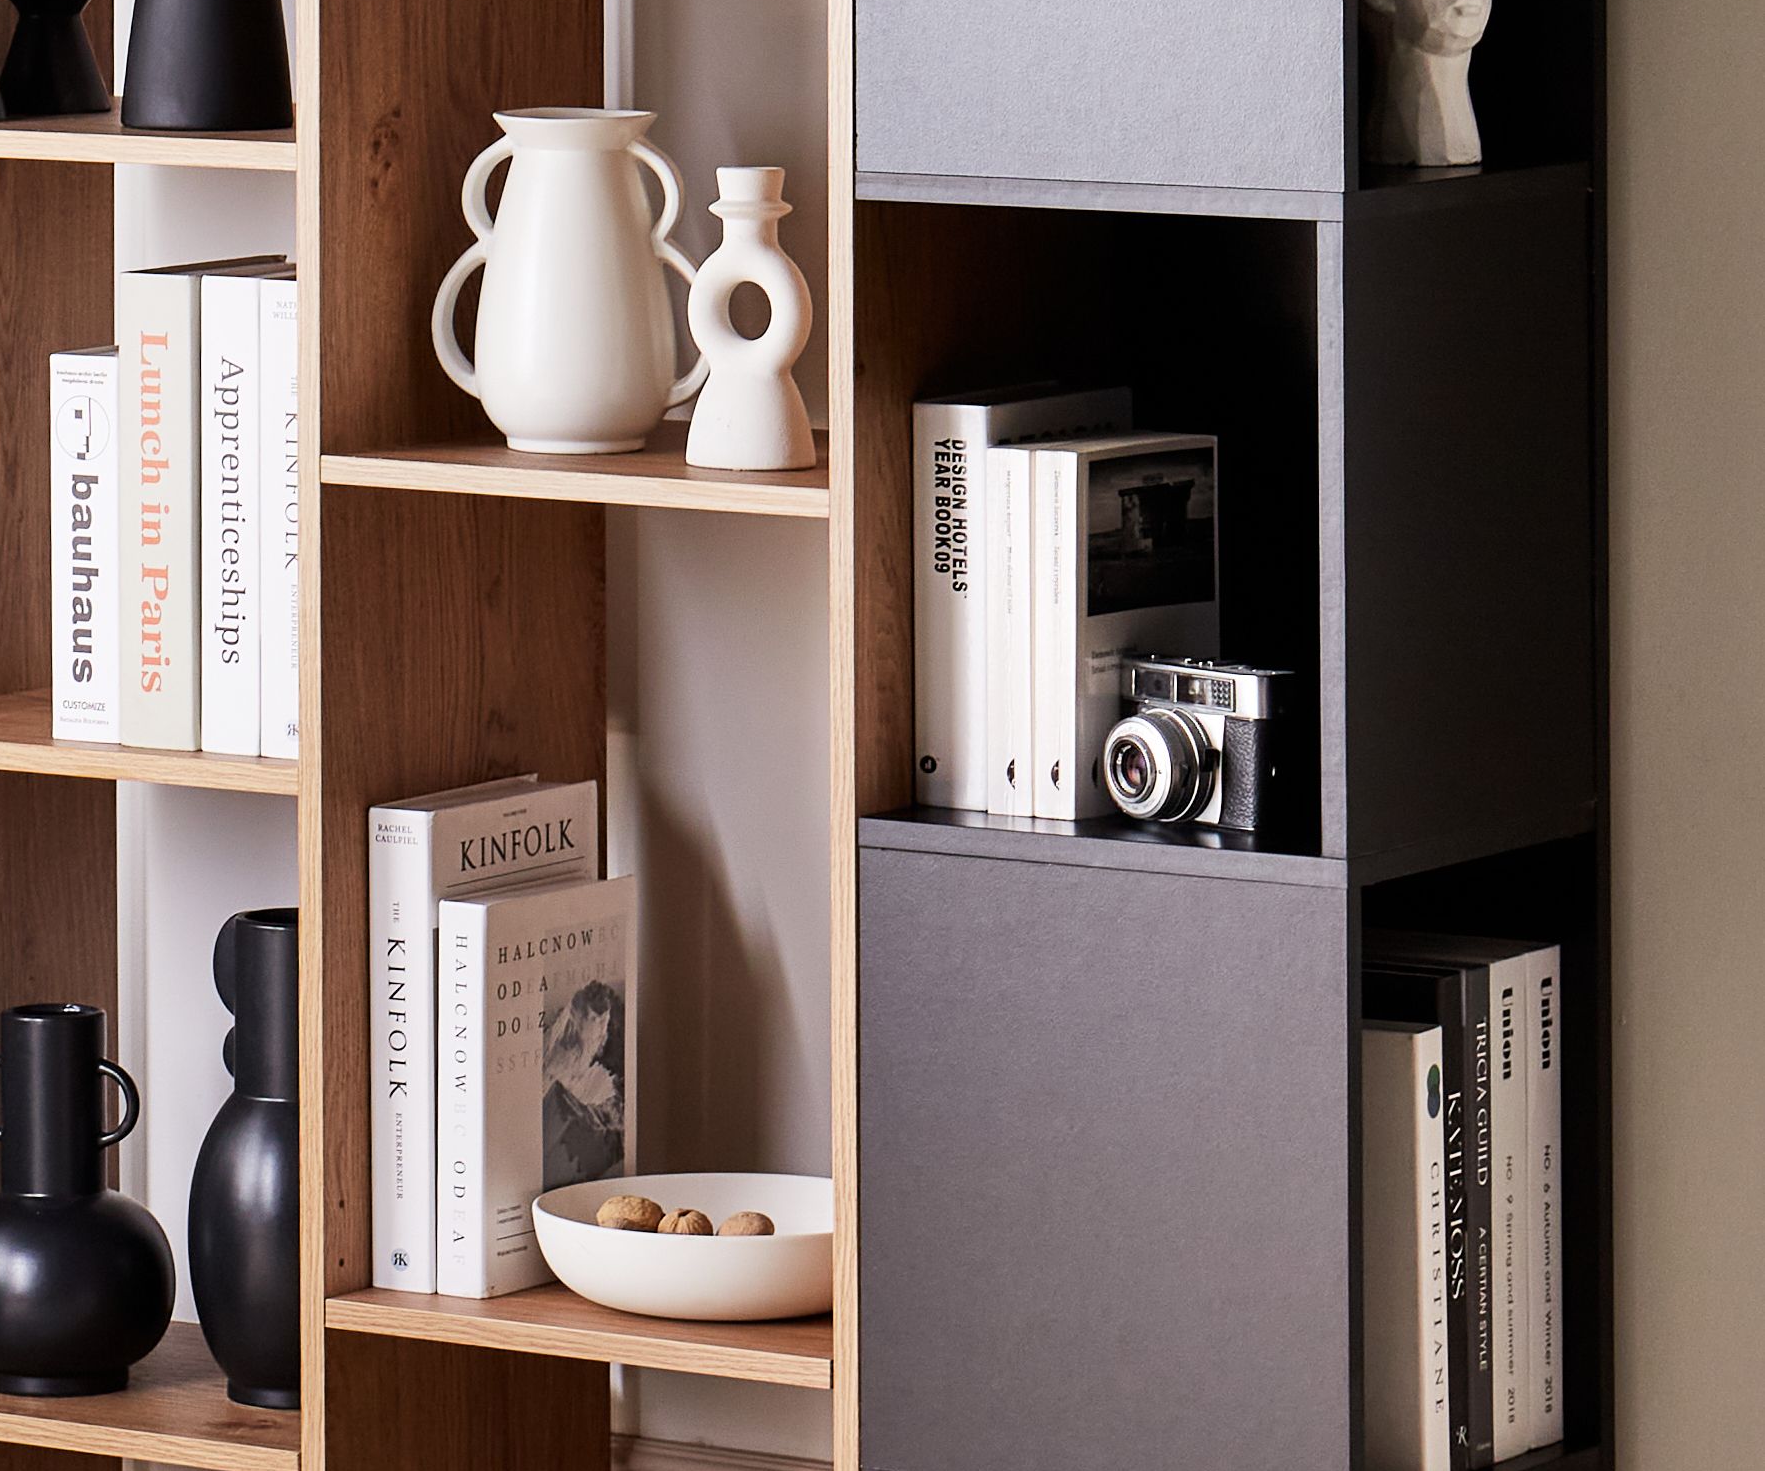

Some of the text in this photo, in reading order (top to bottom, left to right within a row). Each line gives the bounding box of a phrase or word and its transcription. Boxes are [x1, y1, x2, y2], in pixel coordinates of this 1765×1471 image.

[284, 412, 298, 570] KINFOLK
[934, 438, 951, 488] YEAR
[140, 331, 170, 692] Lunch in Paris
[214, 356, 246, 664] Apprenticeships
[952, 439, 968, 593] DESIGN HOTELS
[71, 474, 99, 683] bauhaus
[377, 823, 413, 834] RACHEL
[460, 818, 575, 872] KINFOLK
[387, 938, 407, 1099] KINFOLK
[1477, 1017, 1487, 1102] TRICIA
[1502, 987, 1513, 1080] Union
[1541, 976, 1552, 1070] Union
[1477, 1108, 1488, 1186] GUILD
[1479, 1227, 1486, 1238] A
[1431, 1162, 1444, 1414] CHRISTIANE
[1479, 1320, 1488, 1371] STYLE
[1507, 1387, 1515, 1424] 2018
[1545, 1377, 1553, 1415] 2018
